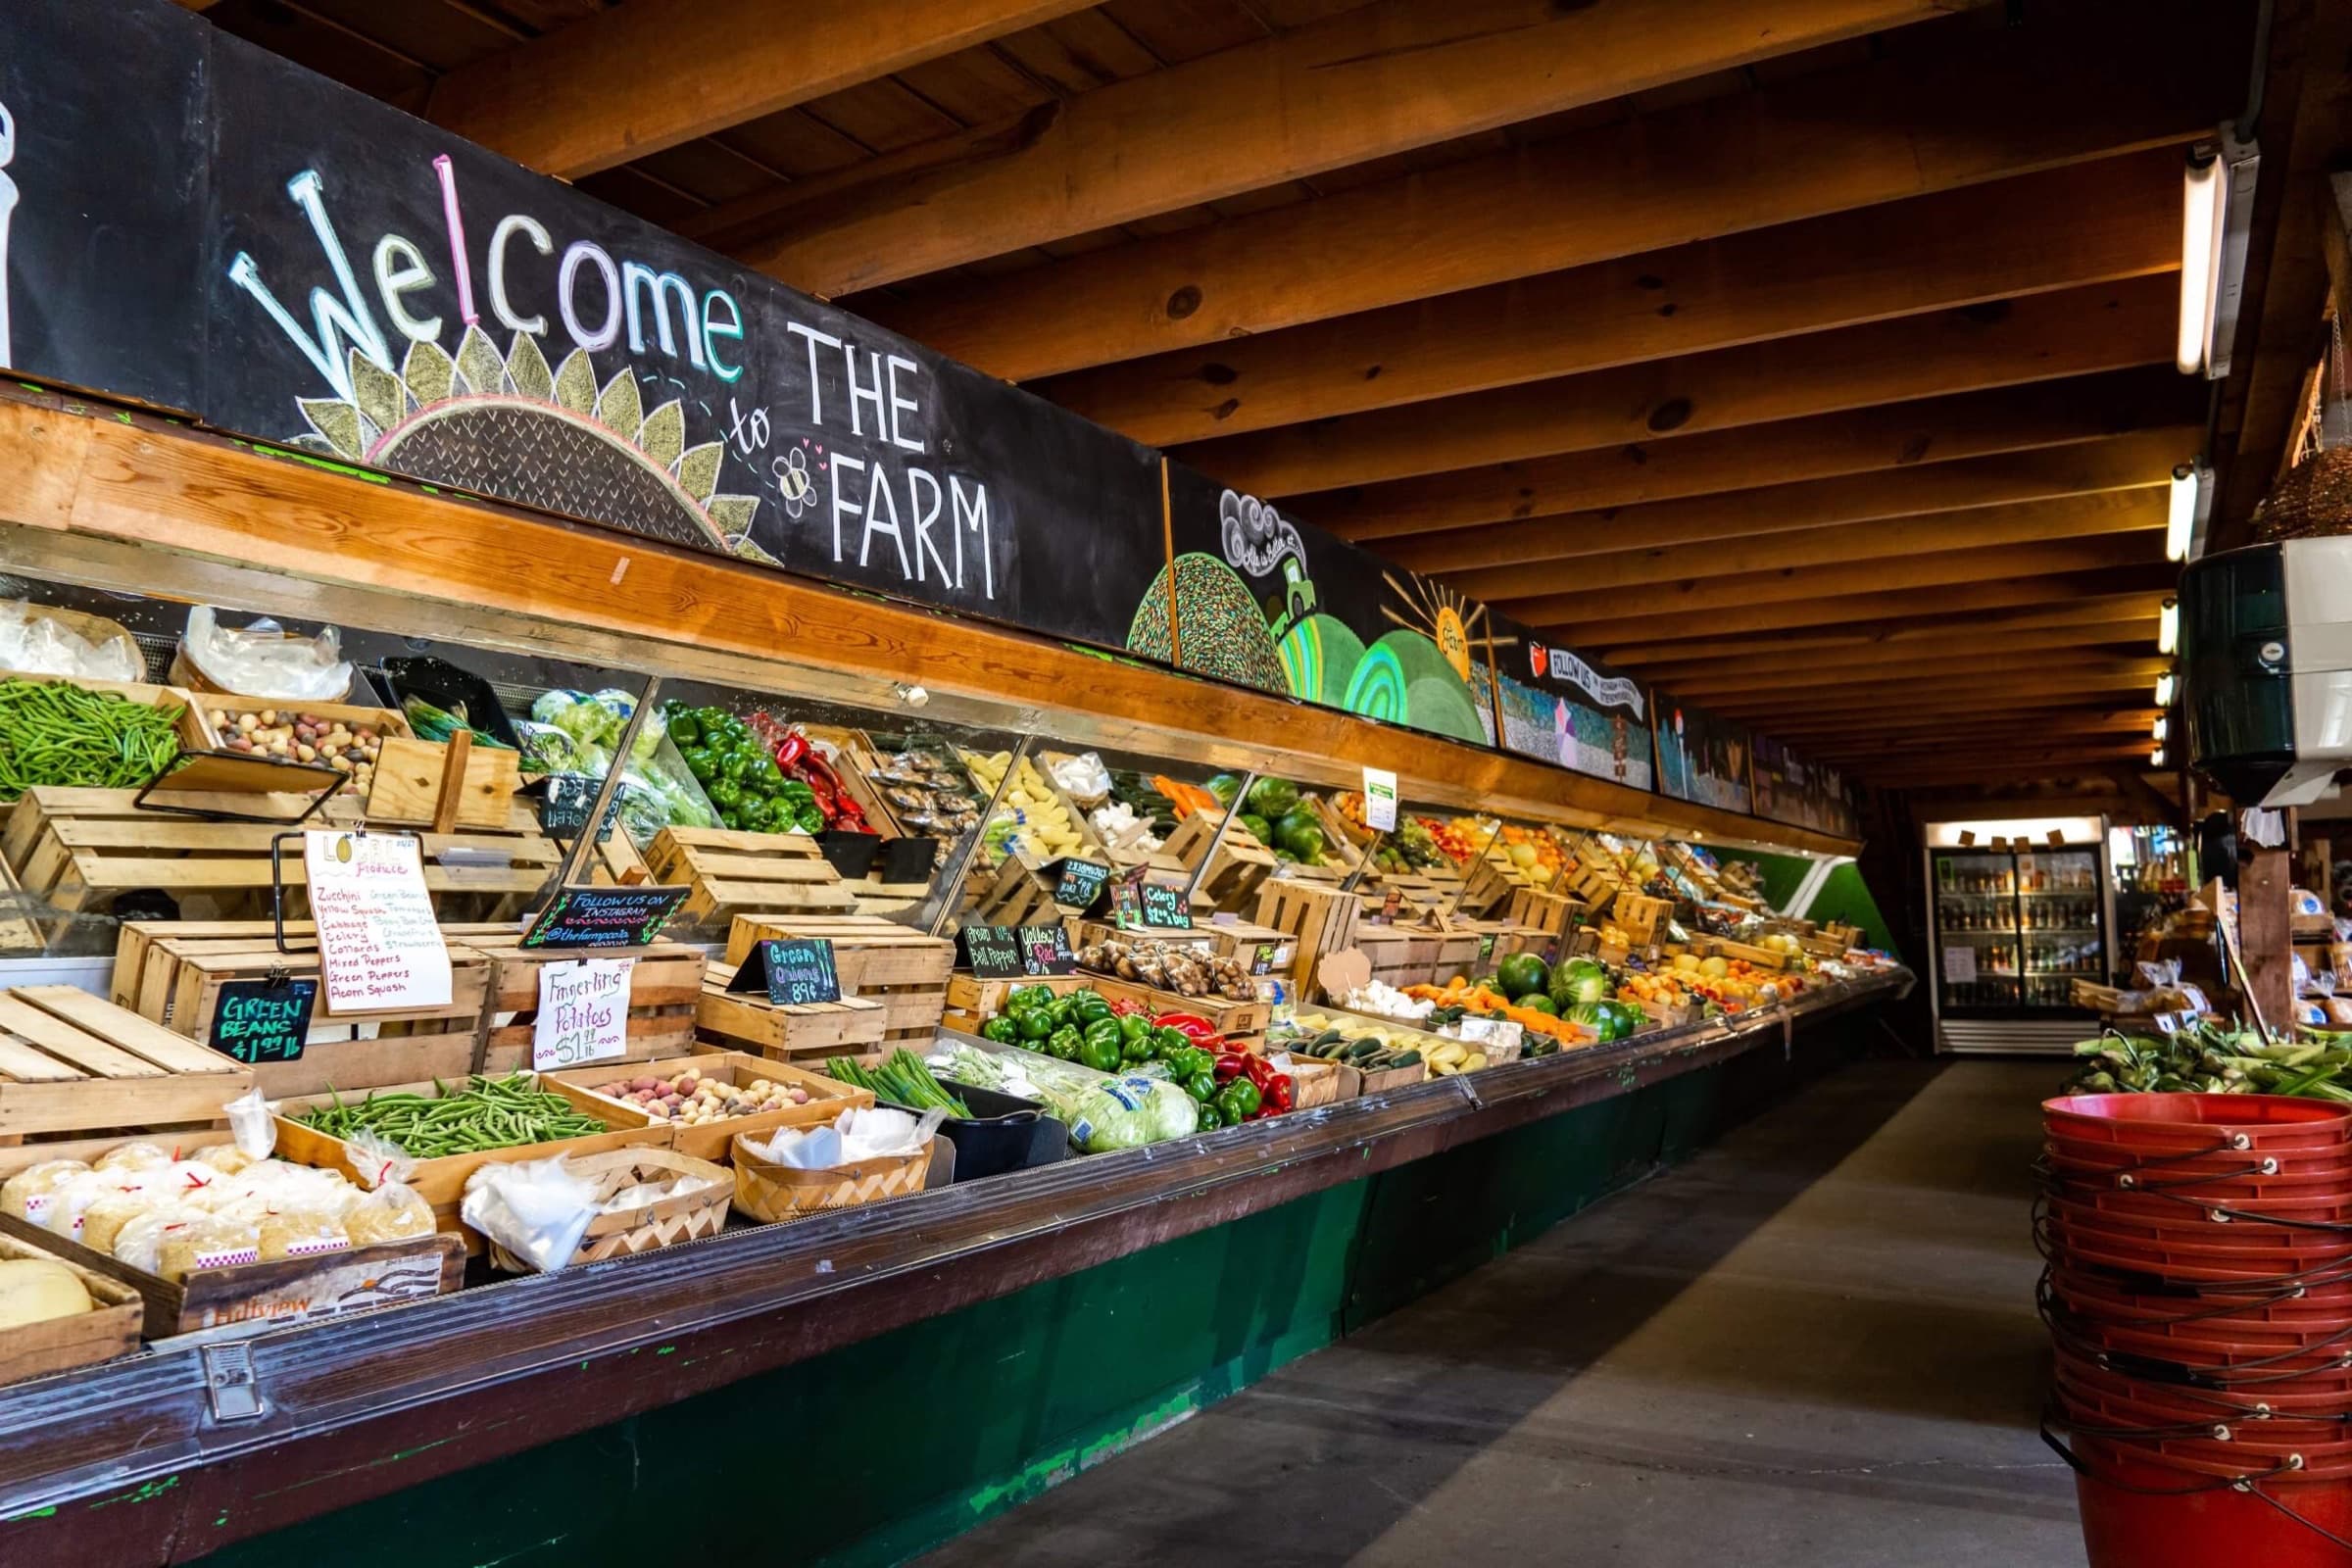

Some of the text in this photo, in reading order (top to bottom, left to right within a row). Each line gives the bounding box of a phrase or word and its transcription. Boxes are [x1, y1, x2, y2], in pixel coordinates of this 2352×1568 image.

[228, 154, 744, 405] Welcome
[787, 321, 925, 454] THE
[730, 397, 771, 455] to
[830, 451, 994, 600] FARM
[1553, 654, 1580, 679] FOLLOW
[1580, 662, 1592, 689] US
[317, 886, 361, 902] Zucchini
[572, 893, 670, 908] FOLLOW US ON
[1147, 887, 1176, 910] Celery
[581, 906, 647, 917] INSTAGRAM
[321, 920, 368, 932] Cabbage
[325, 932, 368, 944] Celery
[328, 944, 380, 956] Collards
[769, 944, 815, 964] Green
[1034, 944, 1056, 964] Red
[329, 954, 401, 969] Mixed Peppers
[329, 969, 410, 983] Green Peppers
[331, 983, 407, 999] Acorn Squash
[549, 972, 621, 1008] Fingerling
[222, 997, 302, 1020] GREEN
[220, 1020, 292, 1040] BEANS
